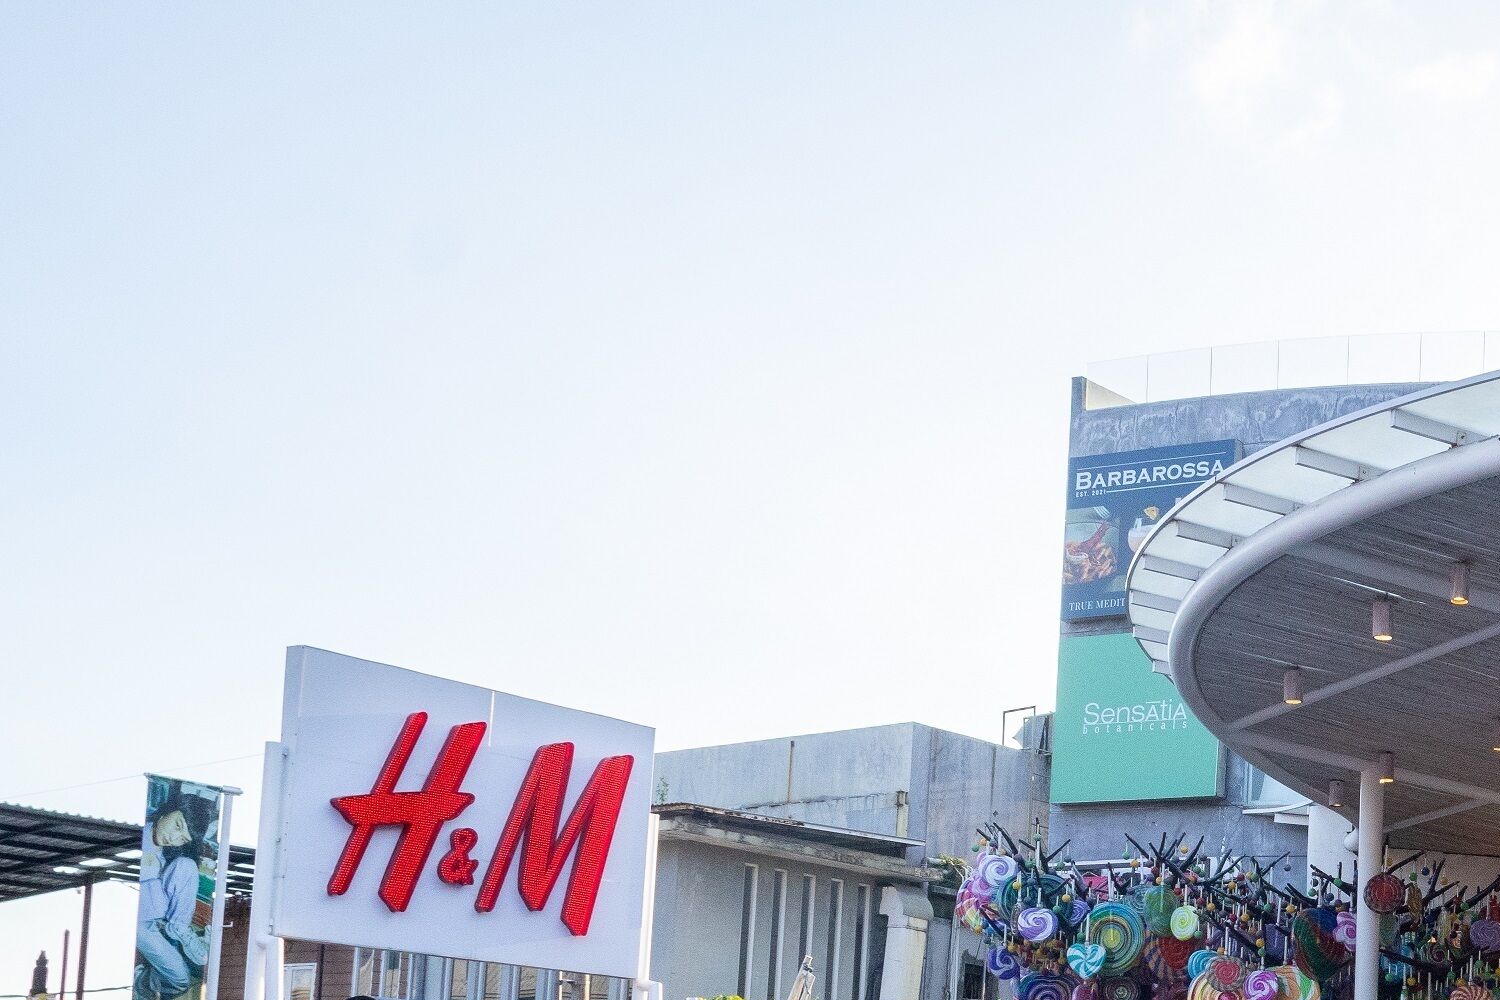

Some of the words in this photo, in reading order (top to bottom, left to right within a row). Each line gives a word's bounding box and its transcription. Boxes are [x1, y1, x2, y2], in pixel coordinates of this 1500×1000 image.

[1076, 460, 1224, 490] BARBAROSSA
[1069, 600, 1093, 611] TRUE
[327, 711, 634, 937] H&M
